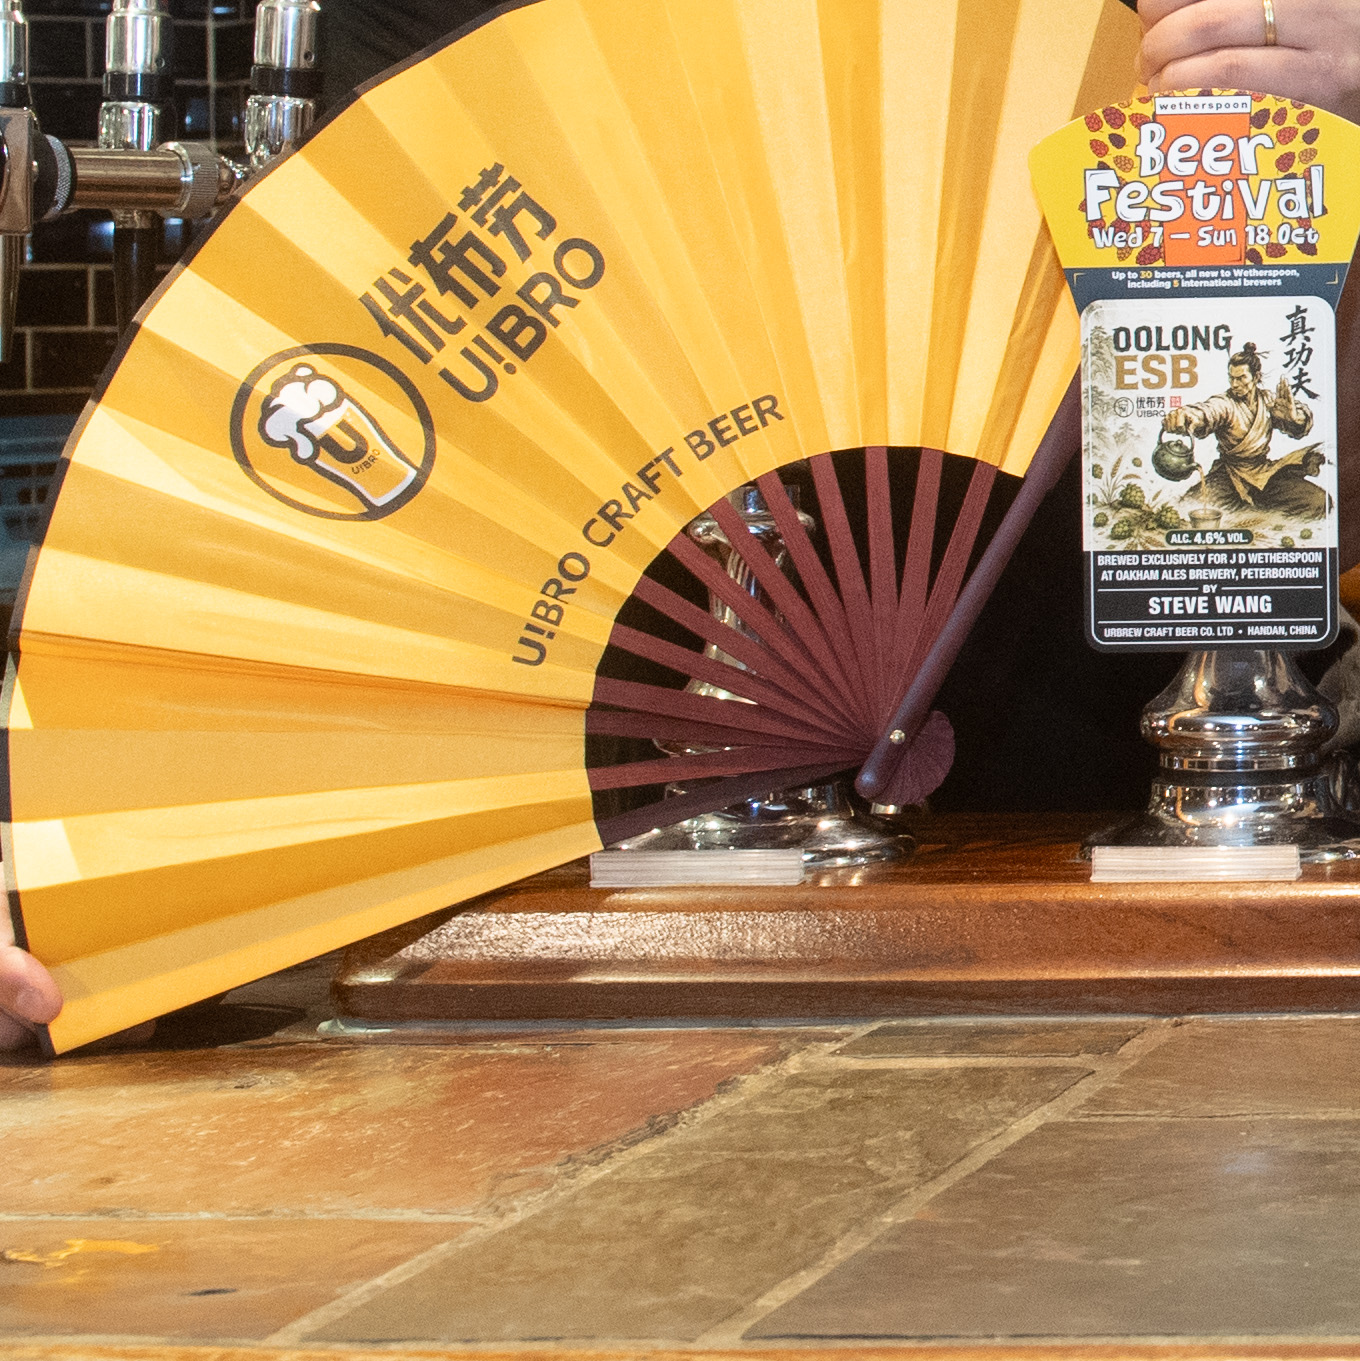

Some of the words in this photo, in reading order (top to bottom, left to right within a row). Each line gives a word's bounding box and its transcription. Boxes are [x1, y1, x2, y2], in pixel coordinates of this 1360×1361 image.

[1158, 100, 1249, 112] wetherspoon
[1135, 122, 1275, 178] Beer
[1084, 164, 1325, 223] Festival
[358, 162, 557, 365] 优布劳
[1112, 324, 1232, 353] OOLONG
[1279, 304, 1321, 400] 真功夫
[1113, 353, 1198, 390] ESB
[582, 447, 684, 548] CRAFT
[683, 394, 785, 462] BEER
[1170, 533, 1191, 545] ALC.
[1193, 532, 1225, 544] 4.6%
[1226, 532, 1251, 544] VOL.
[1100, 570, 1114, 580] AT
[1115, 569, 1159, 580] OAKHAM
[1161, 569, 1187, 580] ALES
[1188, 568, 1238, 580] BREWERY,
[1240, 567, 1319, 578] PETERBOROUGH
[1148, 596, 1208, 614] STEVE
[1214, 595, 1271, 613] WANG
[1103, 627, 1142, 637] URBREW
[1143, 627, 1173, 636] CRAFT
[1175, 626, 1198, 636] BEER
[1199, 626, 1215, 636] CO.
[1216, 626, 1233, 635] LTD
[1247, 625, 1287, 636] HANDAN,
[1289, 625, 1317, 634] CHINA
